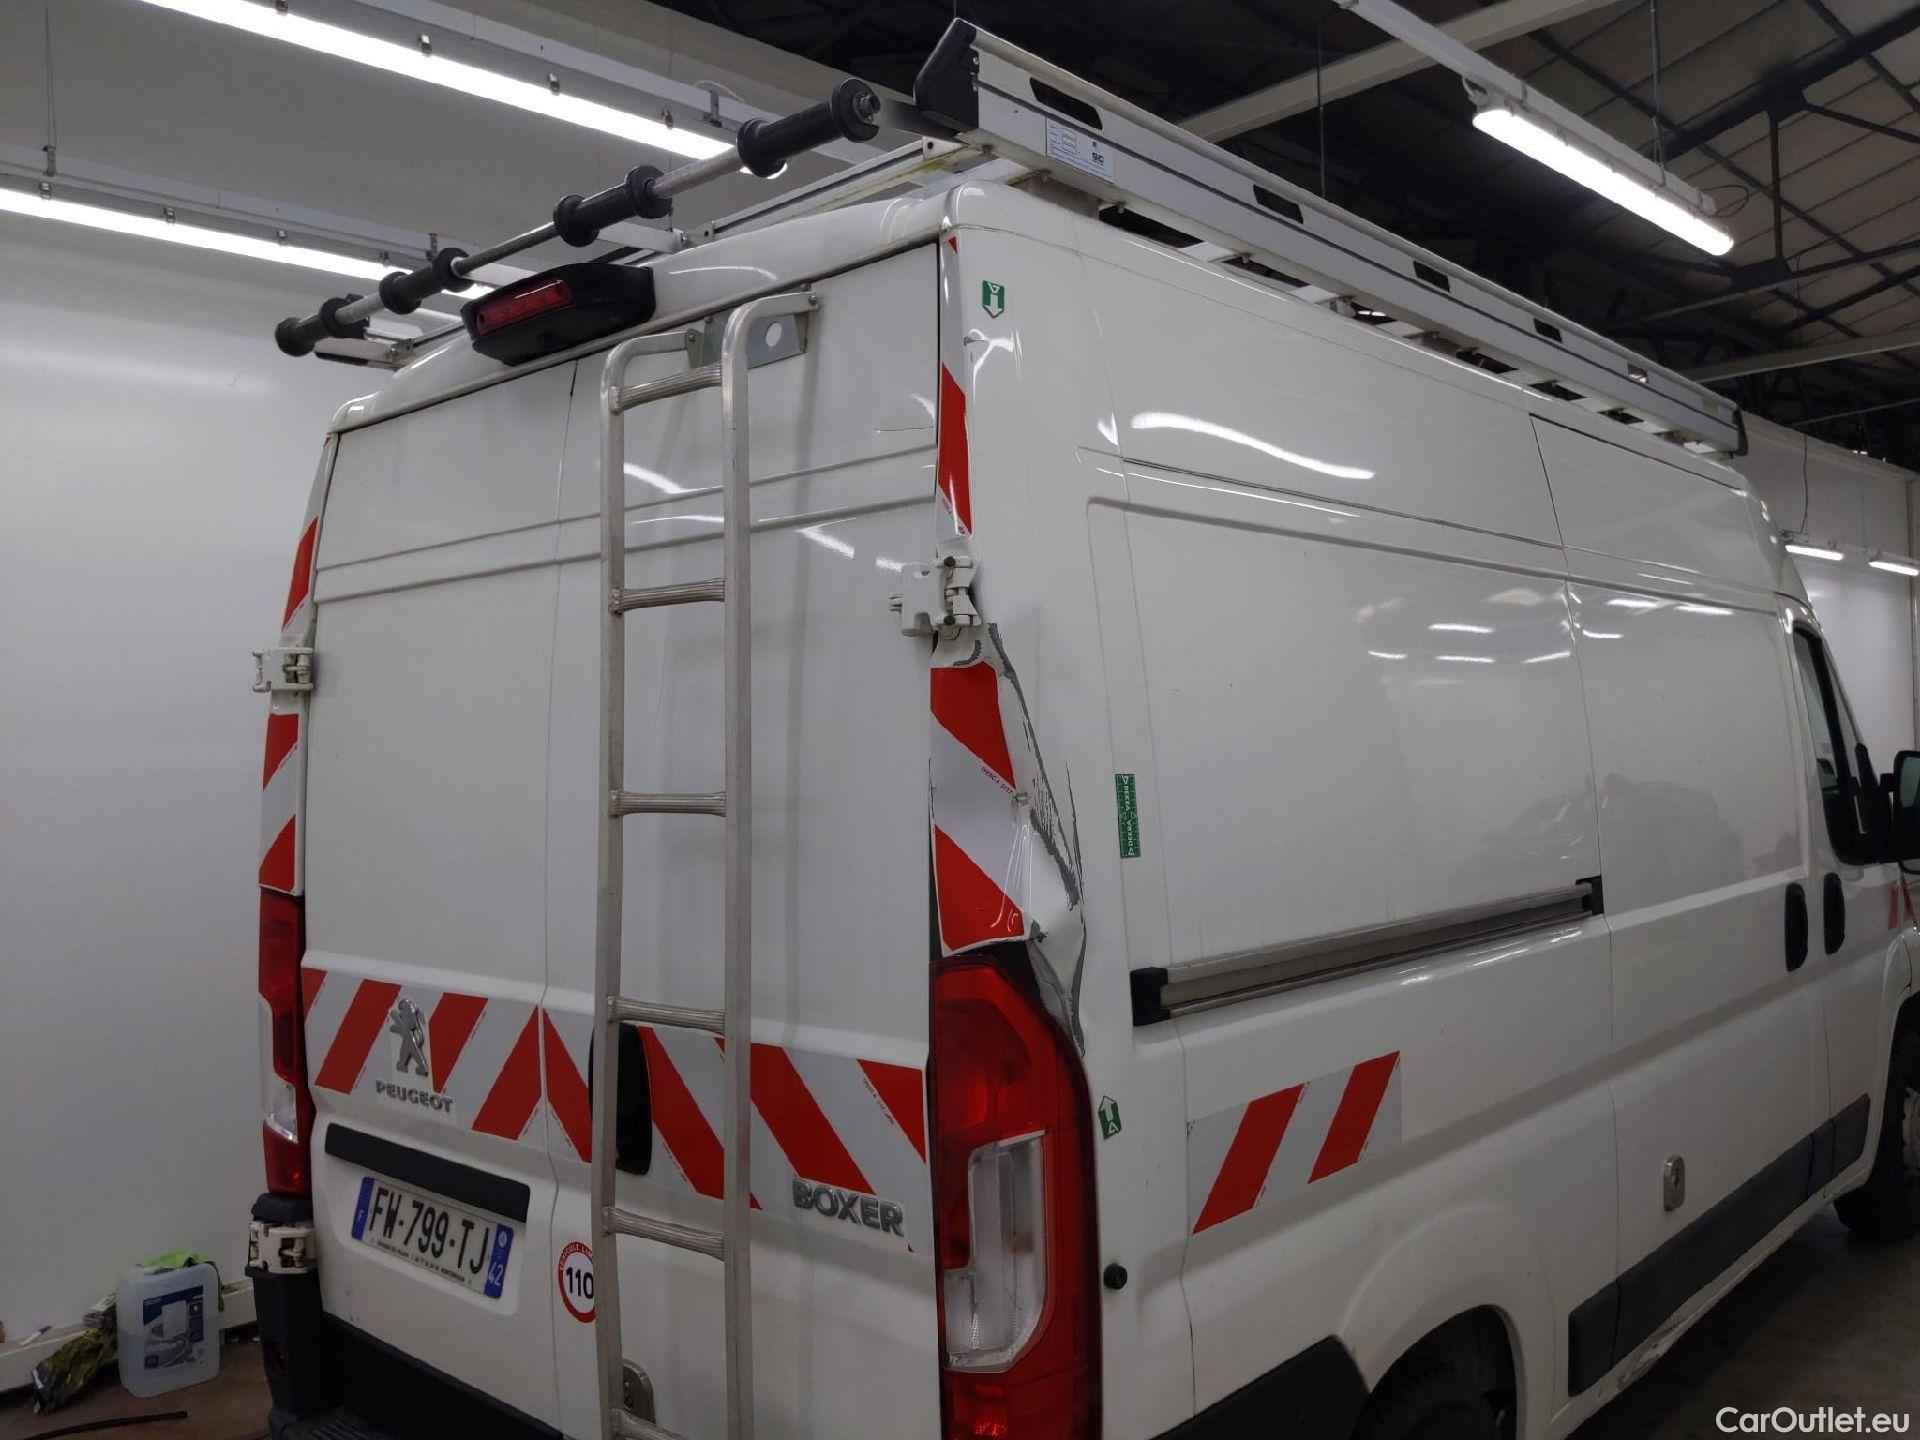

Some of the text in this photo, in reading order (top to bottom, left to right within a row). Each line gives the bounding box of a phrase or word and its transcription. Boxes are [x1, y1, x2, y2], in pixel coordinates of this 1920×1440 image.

[376, 1080, 453, 1113] PEUGEOT
[793, 1179, 904, 1237] BOXER
[369, 1187, 490, 1275] FW-799-TJ
[488, 1261, 504, 1286] 42
[566, 1266, 594, 1299] 110
